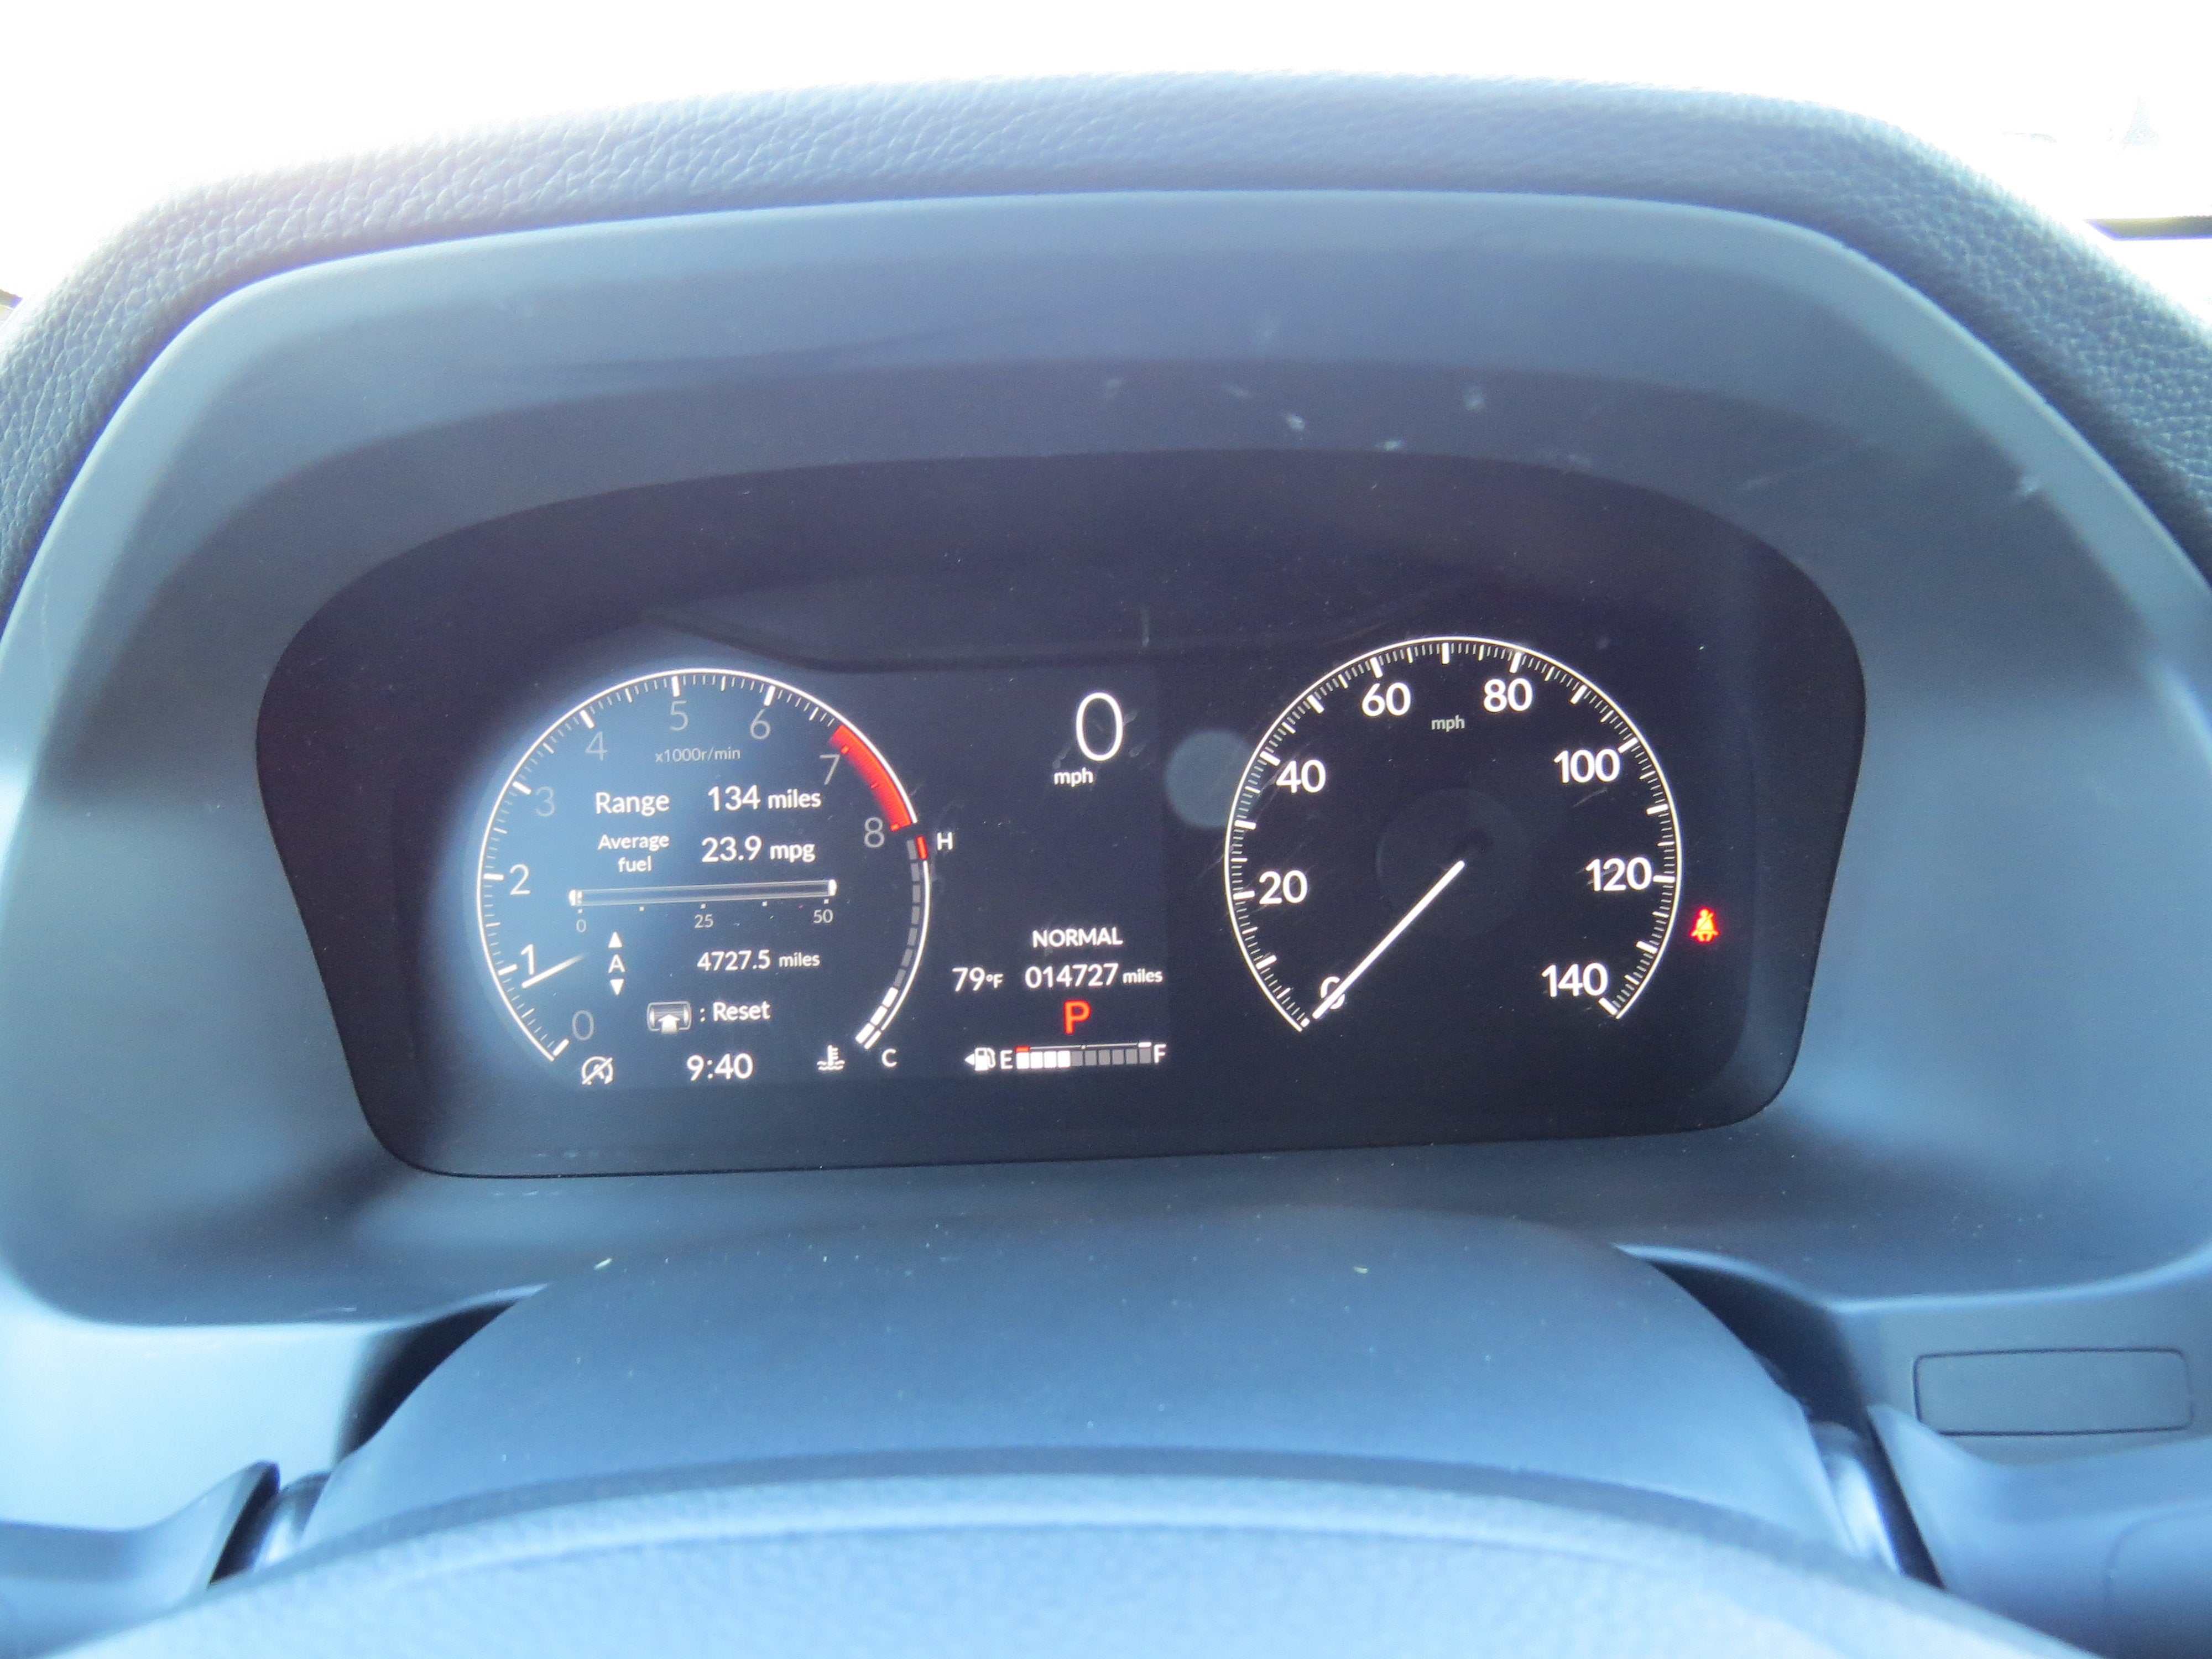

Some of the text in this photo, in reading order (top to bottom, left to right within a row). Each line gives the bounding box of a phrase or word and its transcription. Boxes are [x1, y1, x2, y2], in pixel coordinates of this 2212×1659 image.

[1361, 682, 1411, 716] 60
[1484, 678, 1533, 712] 80
[669, 700, 688, 731] 5
[749, 709, 771, 739] 6
[1076, 692, 1123, 761] 0
[1432, 715, 1465, 732] mph
[585, 731, 607, 760] 4
[655, 747, 741, 763] x1000r/min
[820, 754, 839, 785] 7
[1053, 767, 1093, 787] mph
[1276, 759, 1326, 794] 40
[1553, 749, 1621, 784] 100
[535, 786, 555, 816] 3
[596, 785, 821, 816] Range 134 miles
[598, 834, 669, 852] Average
[864, 817, 884, 848] 8
[937, 832, 953, 850] H
[702, 836, 815, 863] 23.9 mpg
[618, 856, 651, 873] fuel
[1585, 857, 1652, 891] 120
[510, 864, 531, 895] 2
[1259, 869, 1307, 905] 20
[576, 919, 586, 932] 0
[695, 914, 713, 928] 25
[813, 909, 833, 924] 50
[1032, 927, 1123, 948] NORMAL
[520, 944, 535, 975] 1
[609, 954, 625, 973] A
[697, 950, 820, 972] 4727.5 miles
[1025, 963, 1163, 989] 014727 miles
[1541, 962, 1608, 997] 140
[713, 1001, 770, 1021] Reset
[1064, 1000, 1091, 1035] P
[572, 1010, 594, 1041] 0
[687, 1053, 753, 1081] 9:40
[882, 1049, 898, 1067] C
[1000, 1050, 1013, 1070] E
[1154, 1044, 1167, 1064] F
